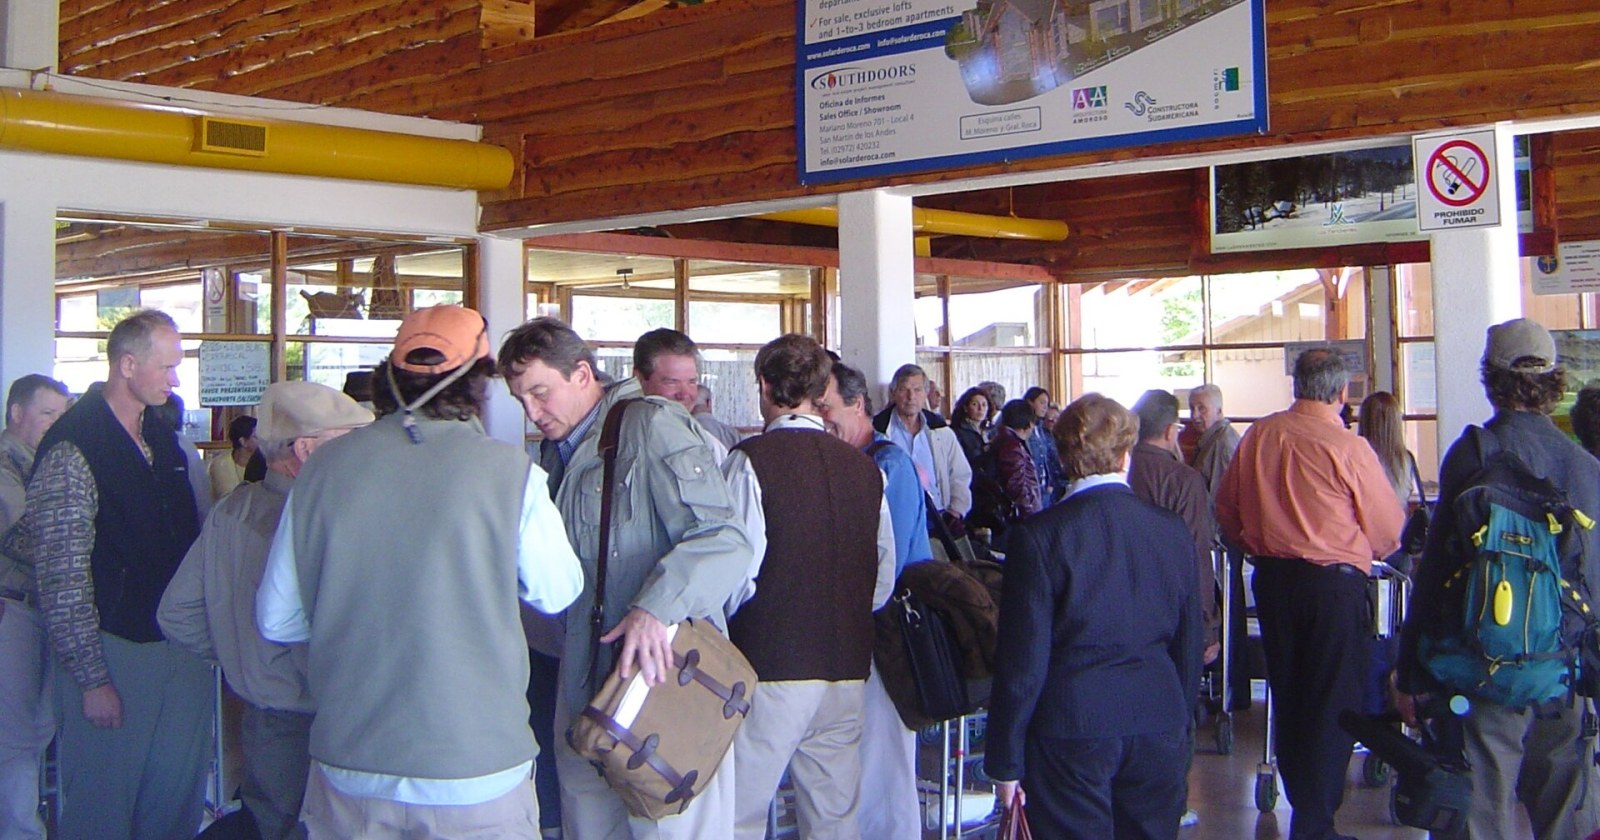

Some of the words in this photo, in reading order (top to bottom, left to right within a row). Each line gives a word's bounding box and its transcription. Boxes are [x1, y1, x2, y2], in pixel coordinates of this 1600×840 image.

[819, 18, 831, 27] For
[834, 13, 851, 23] sale,
[854, 5, 890, 20] exclusive
[893, 1, 912, 12] lofts
[819, 29, 832, 39] and
[836, 22, 864, 35] 1-to-3
[867, 15, 902, 30] bedroom
[905, 5, 954, 23] apartments
[806, 43, 871, 61] www.solarderoca.com
[877, 30, 946, 47] info@solarderoca.com
[819, 64, 916, 90] SOUTHDOORS
[819, 98, 843, 110] Oficina
[845, 97, 853, 105] de
[855, 94, 885, 104] Informes
[819, 112, 837, 121] Sales
[838, 109, 858, 119] Office
[864, 104, 901, 115] Showroom
[819, 124, 845, 133] Mariano
[847, 120, 872, 130] Moreno
[891, 114, 908, 124] Local
[819, 136, 831, 145] San
[855, 132, 863, 140] de
[864, 130, 874, 138] los
[875, 128, 896, 138] Andes
[820, 151, 896, 166] info@solarderoca.com
[1434, 208, 1484, 218] PROHIBIDO
[1443, 216, 1477, 225] FUMAR
